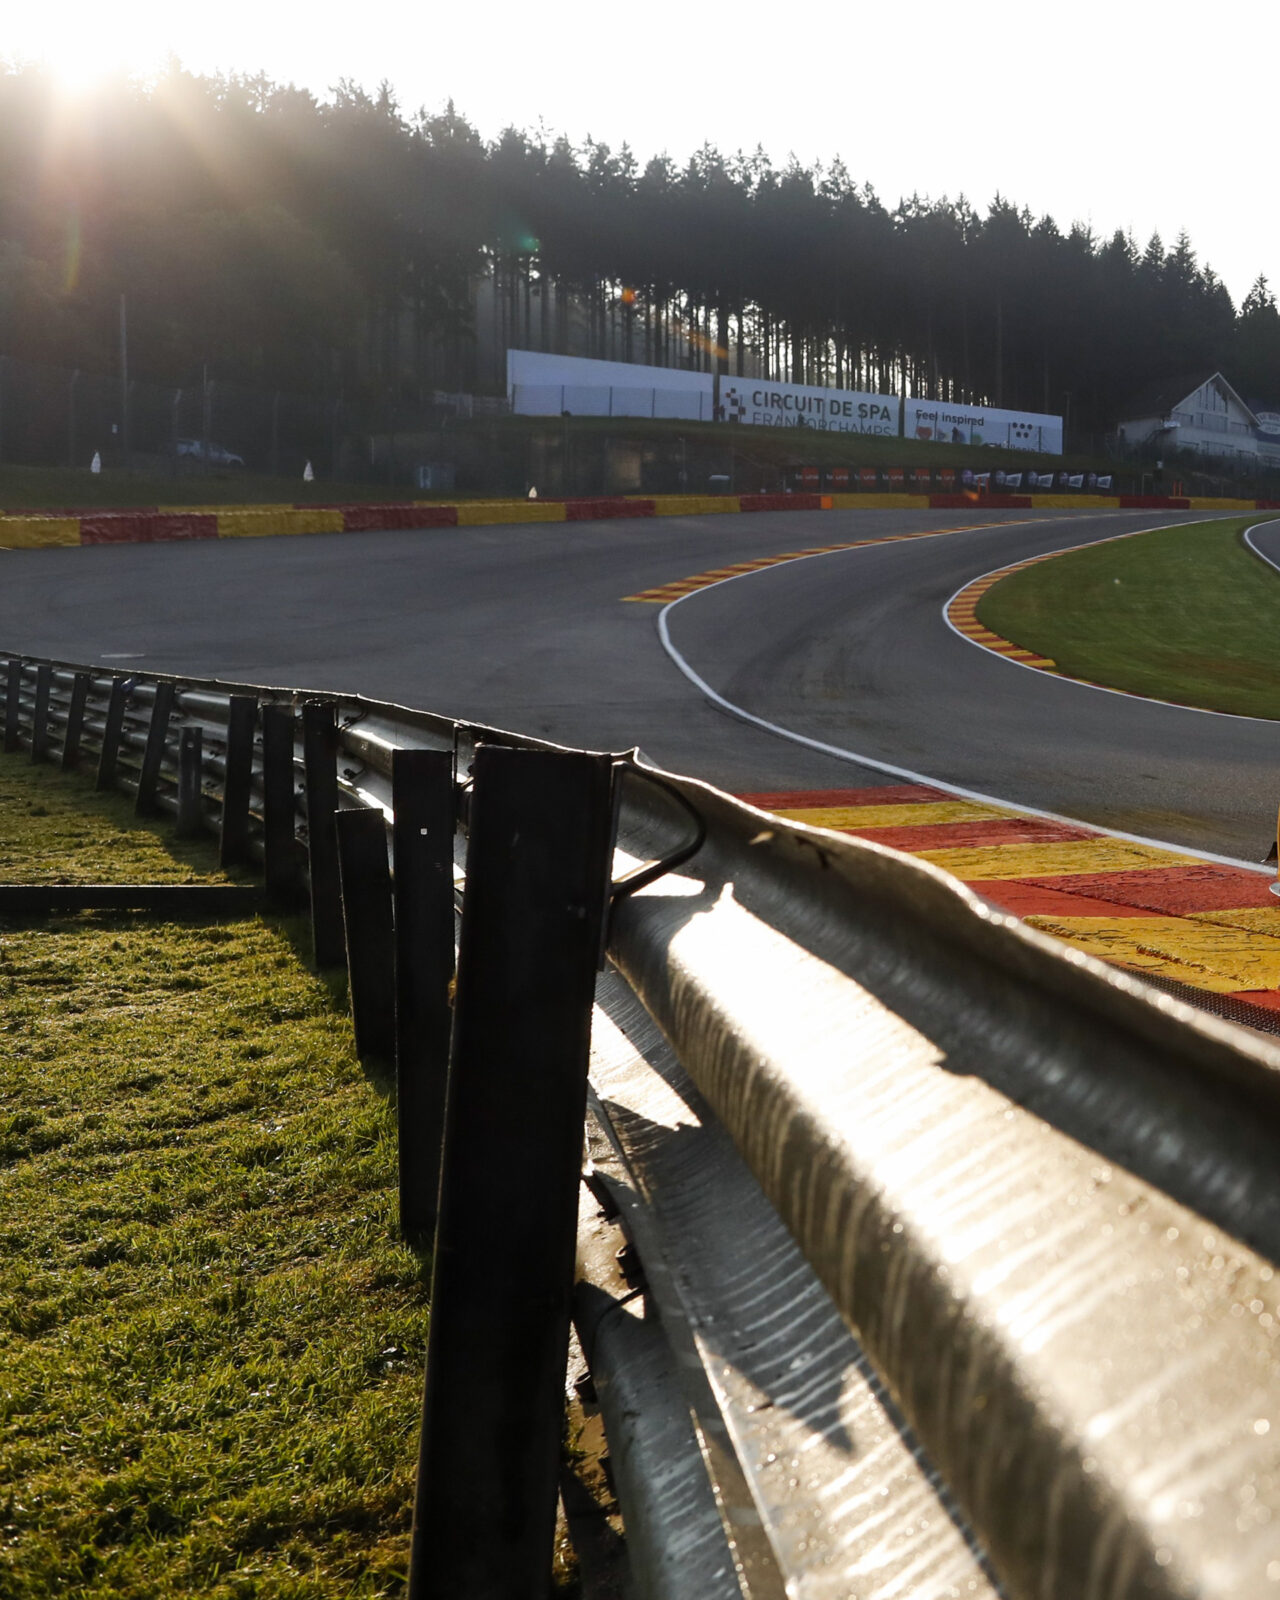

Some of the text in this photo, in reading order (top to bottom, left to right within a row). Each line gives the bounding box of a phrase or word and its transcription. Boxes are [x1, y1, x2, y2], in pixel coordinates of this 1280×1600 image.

[752, 391, 892, 422] CIRCUIT DE SPA
[916, 409, 985, 427] Feel inspired
[752, 412, 893, 437] FRANORCHAMPS
